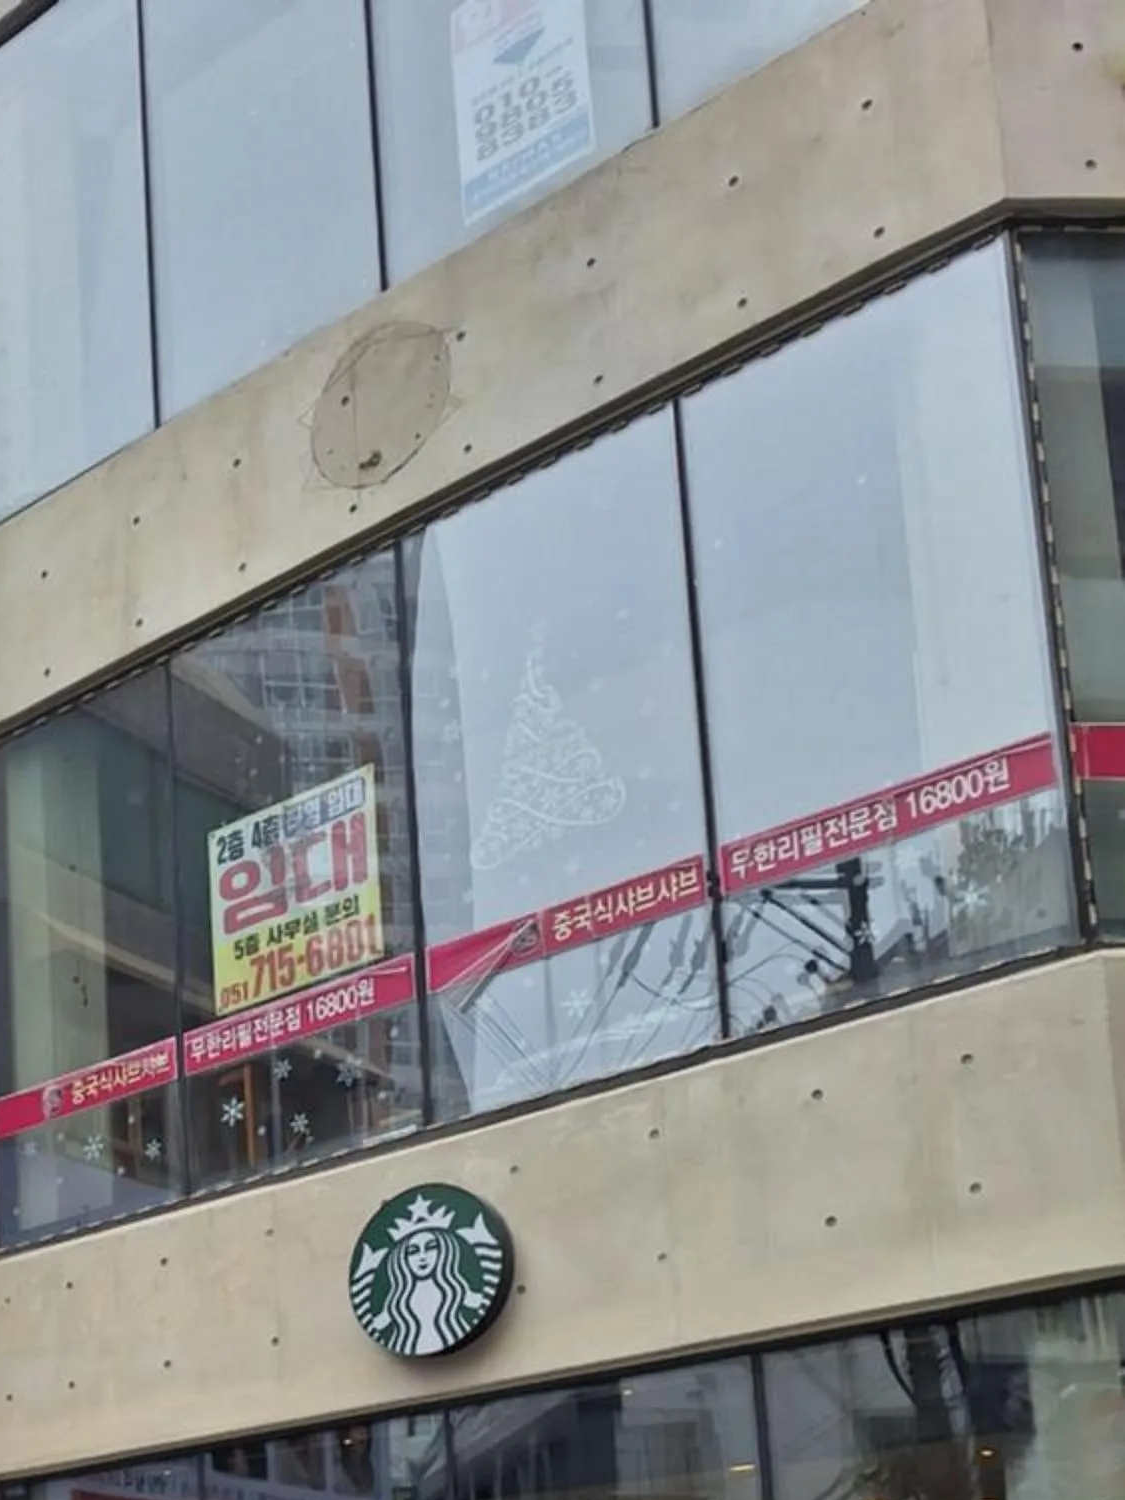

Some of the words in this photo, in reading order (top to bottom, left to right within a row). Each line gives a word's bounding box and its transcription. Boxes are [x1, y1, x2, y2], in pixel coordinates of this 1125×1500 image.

[731, 800, 898, 878] 무한리필전문점
[906, 757, 1011, 818] 16800원
[219, 812, 369, 935] 임대
[553, 867, 701, 941] 중국식샤브샤브
[250, 914, 383, 998] 715-6801
[266, 911, 320, 946] 사무실
[191, 1004, 301, 1063] 무한리필전문점
[307, 978, 374, 1023] 16800원
